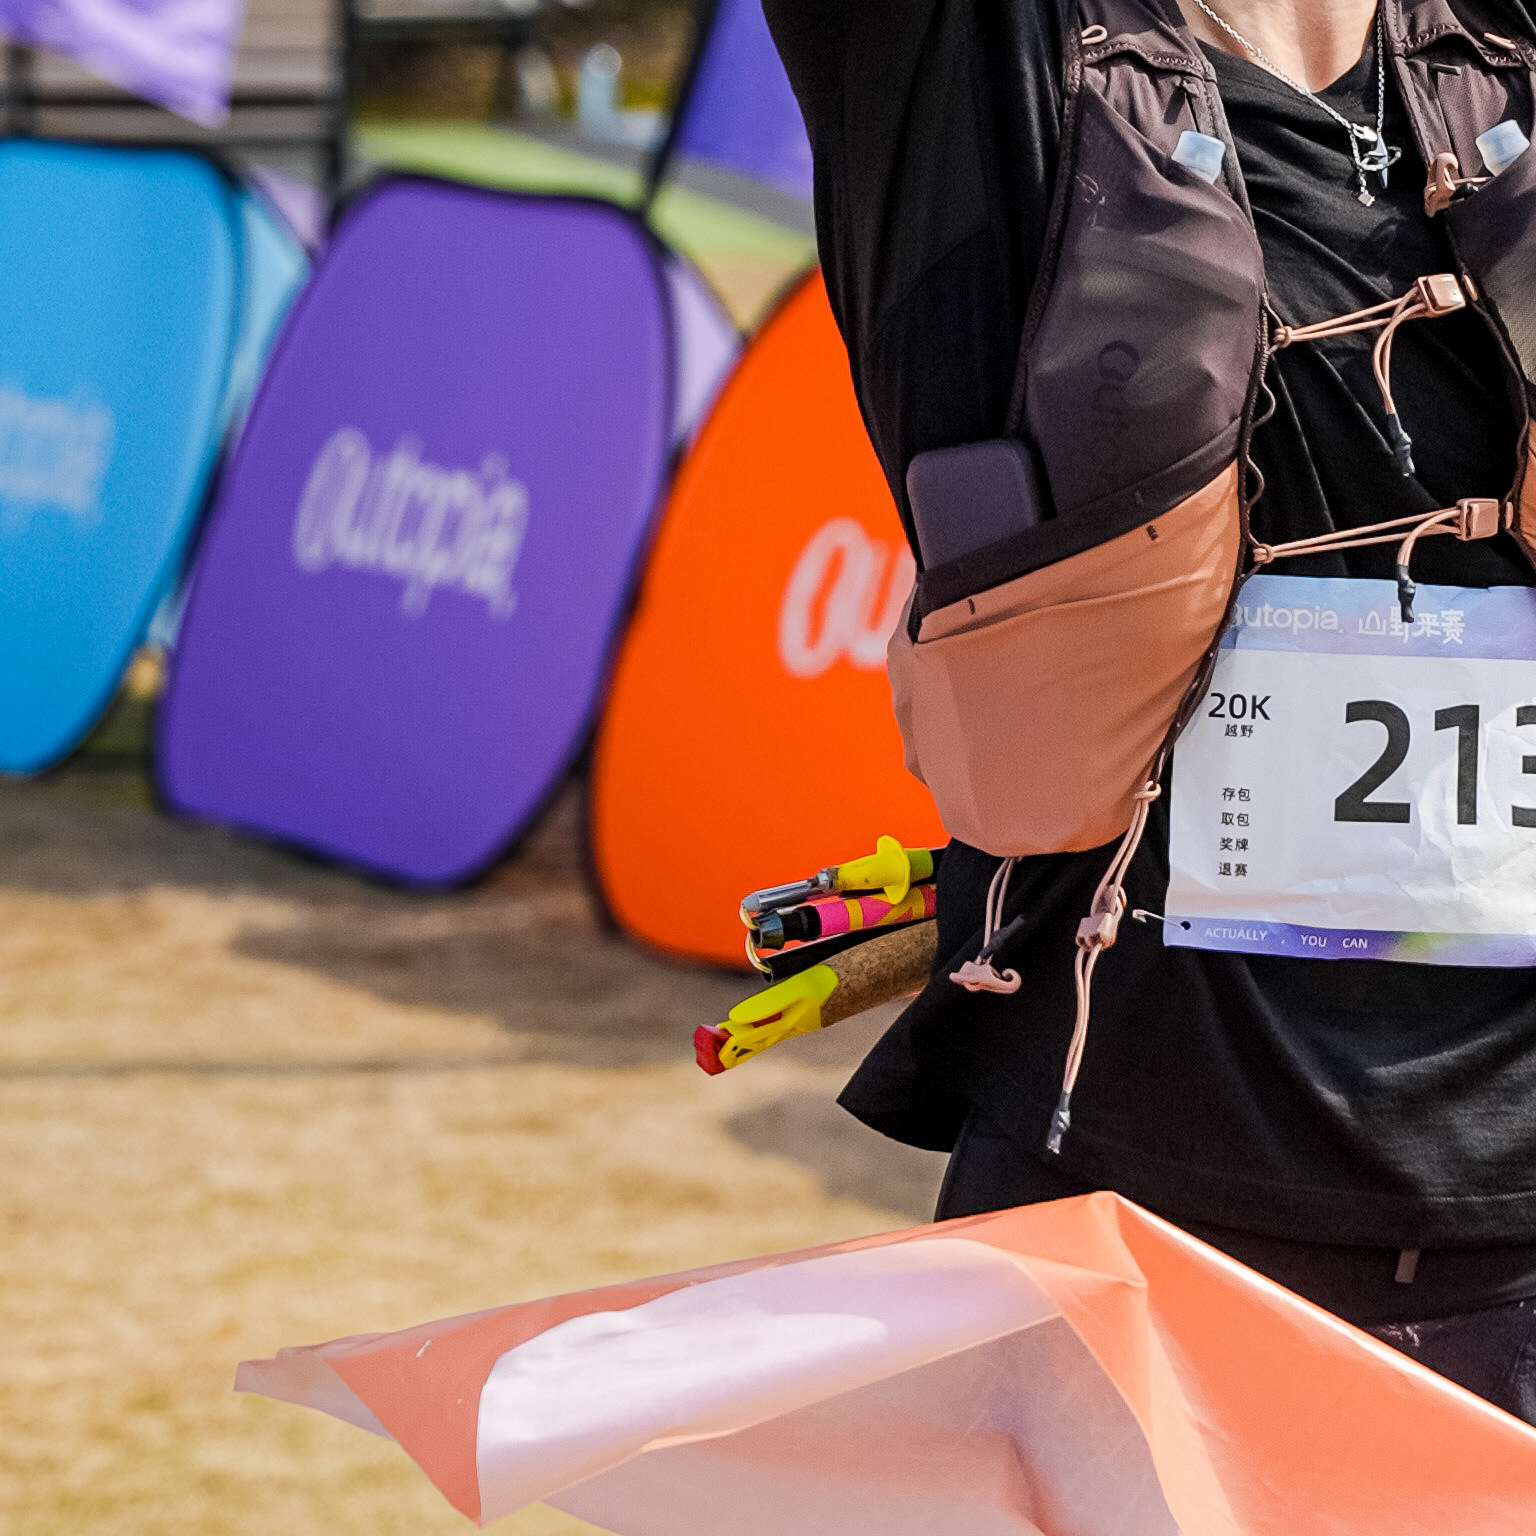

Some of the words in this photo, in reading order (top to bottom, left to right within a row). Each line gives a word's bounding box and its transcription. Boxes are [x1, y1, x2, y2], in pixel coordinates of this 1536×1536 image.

[1208, 692, 1272, 721] 20K
[1222, 786, 1251, 802] 存包
[1220, 811, 1250, 827] 取包
[1219, 836, 1249, 852] 奖牌
[1218, 861, 1248, 877] 退赛
[1204, 927, 1268, 942] ACTUALLY
[1301, 934, 1327, 948] YOU
[1342, 937, 1368, 949] CAN
